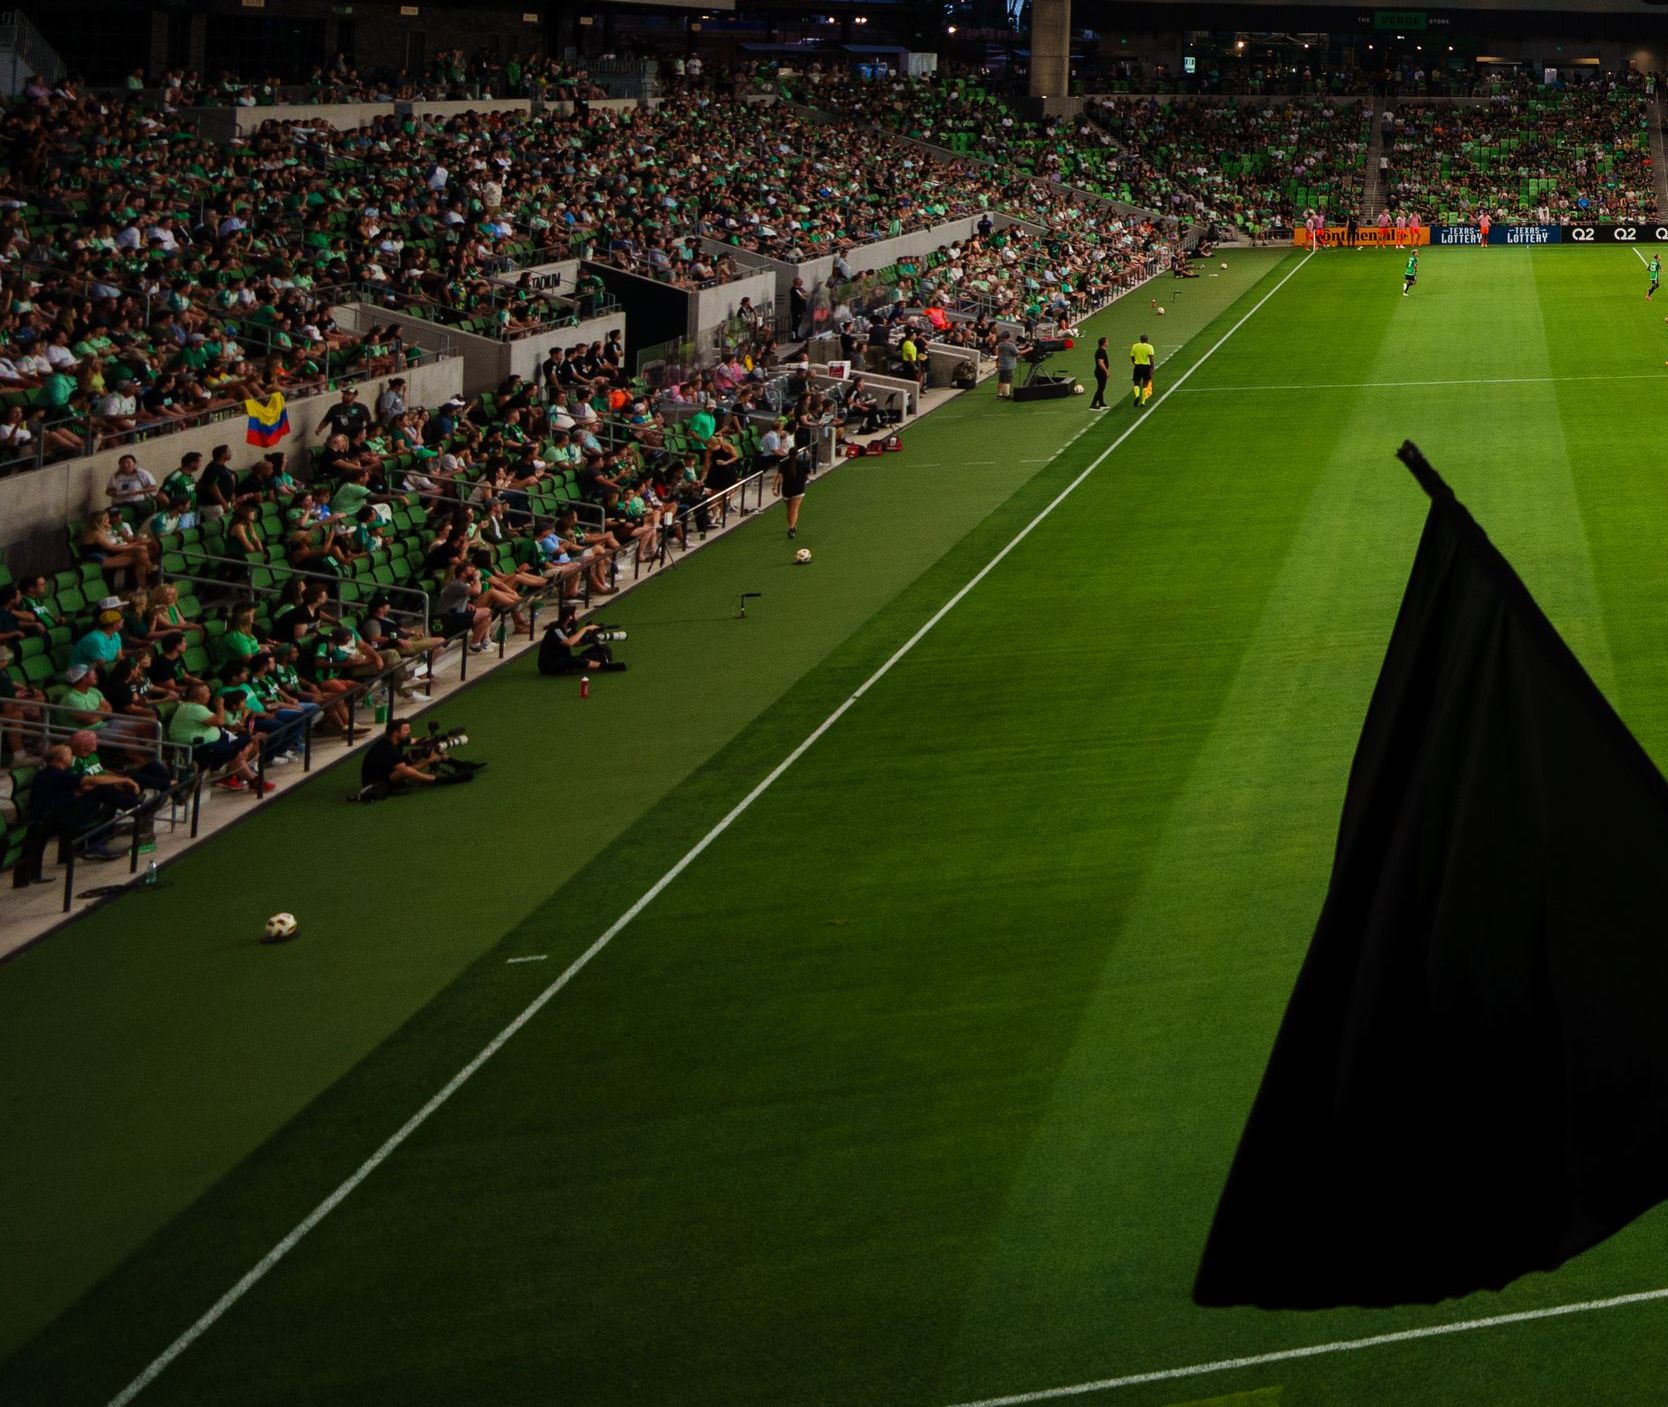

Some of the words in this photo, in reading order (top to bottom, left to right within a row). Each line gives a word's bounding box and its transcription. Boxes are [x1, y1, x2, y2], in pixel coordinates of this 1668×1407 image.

[1441, 233, 1483, 243] LOTTERY
[1507, 233, 1548, 243] LOTTERY
[1572, 227, 1595, 241] Q2
[1613, 227, 1637, 241] Q2
